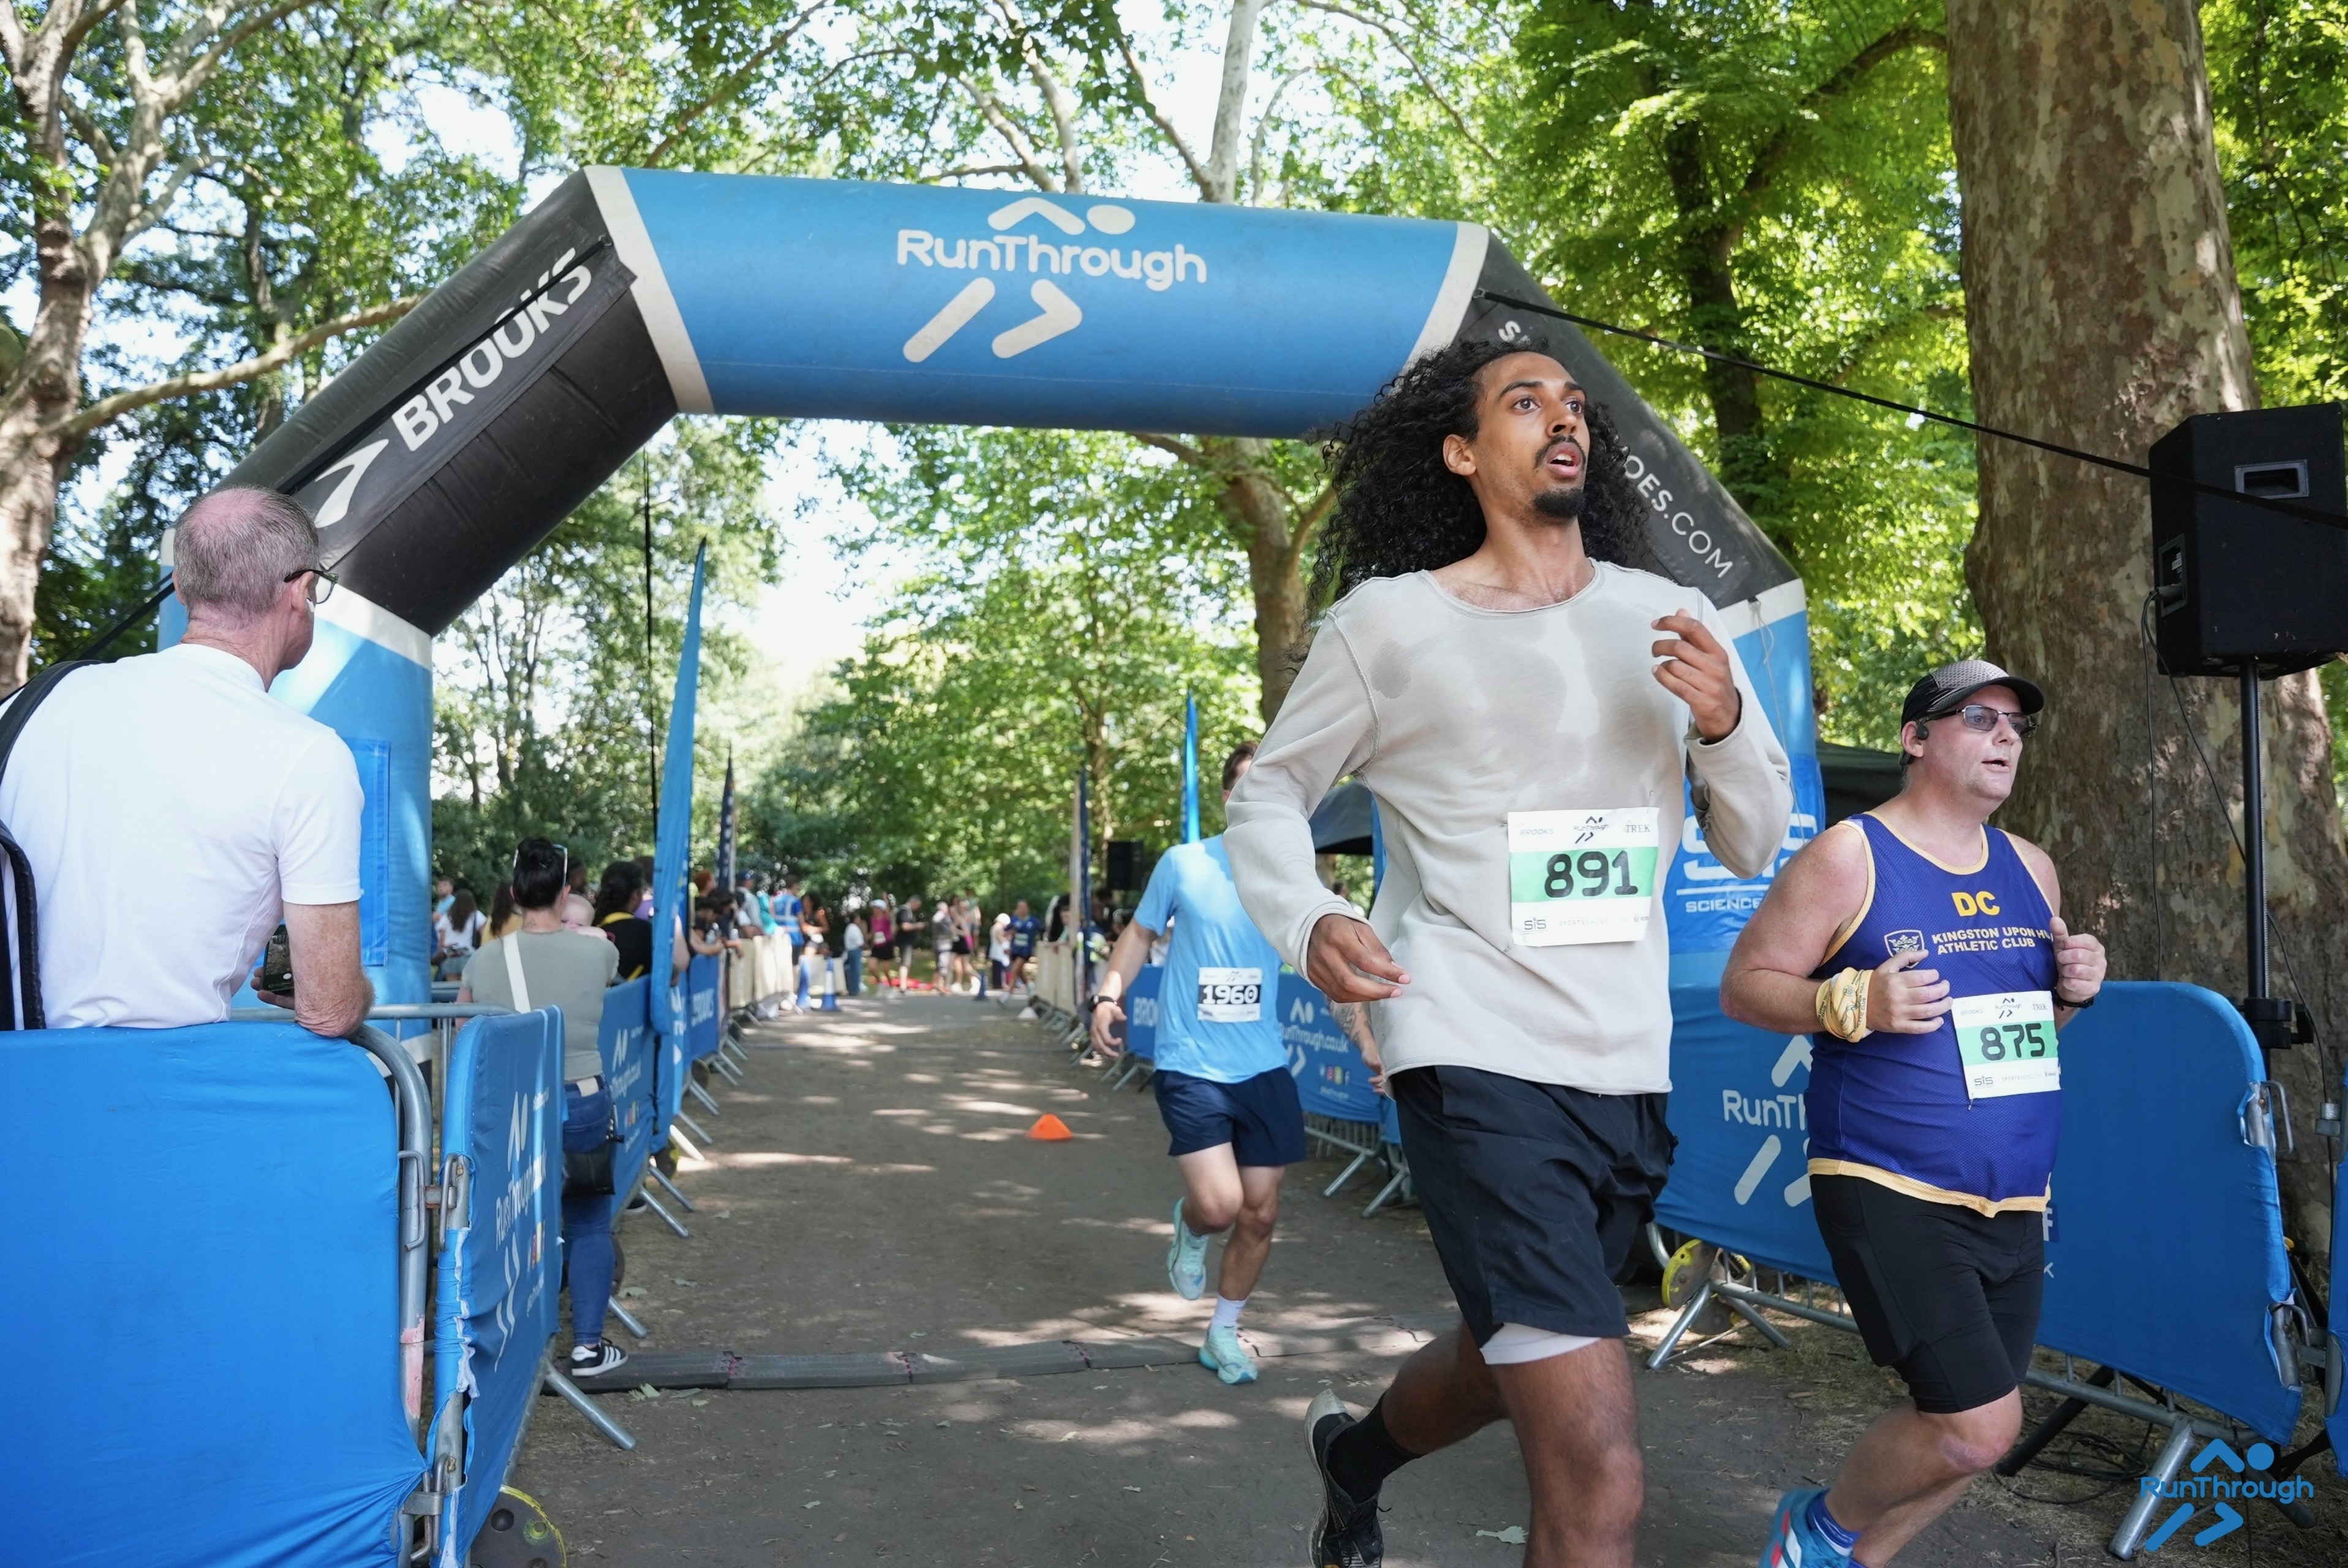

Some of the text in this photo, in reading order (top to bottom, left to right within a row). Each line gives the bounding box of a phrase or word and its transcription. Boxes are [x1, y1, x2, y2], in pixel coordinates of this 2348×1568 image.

[897, 229, 1207, 291] RunThrough
[391, 247, 592, 451] BROOKS
[1625, 824, 1651, 833] TREK
[1544, 850, 1638, 898] 891
[1952, 891, 2000, 916] DC
[1931, 928, 1999, 944] KINGSTON
[2002, 927, 2036, 938] UPON
[1938, 938, 2036, 955] ATHLETIC CLUB
[1202, 984, 1258, 1005] 1960
[1980, 1023, 2045, 1061] 875
